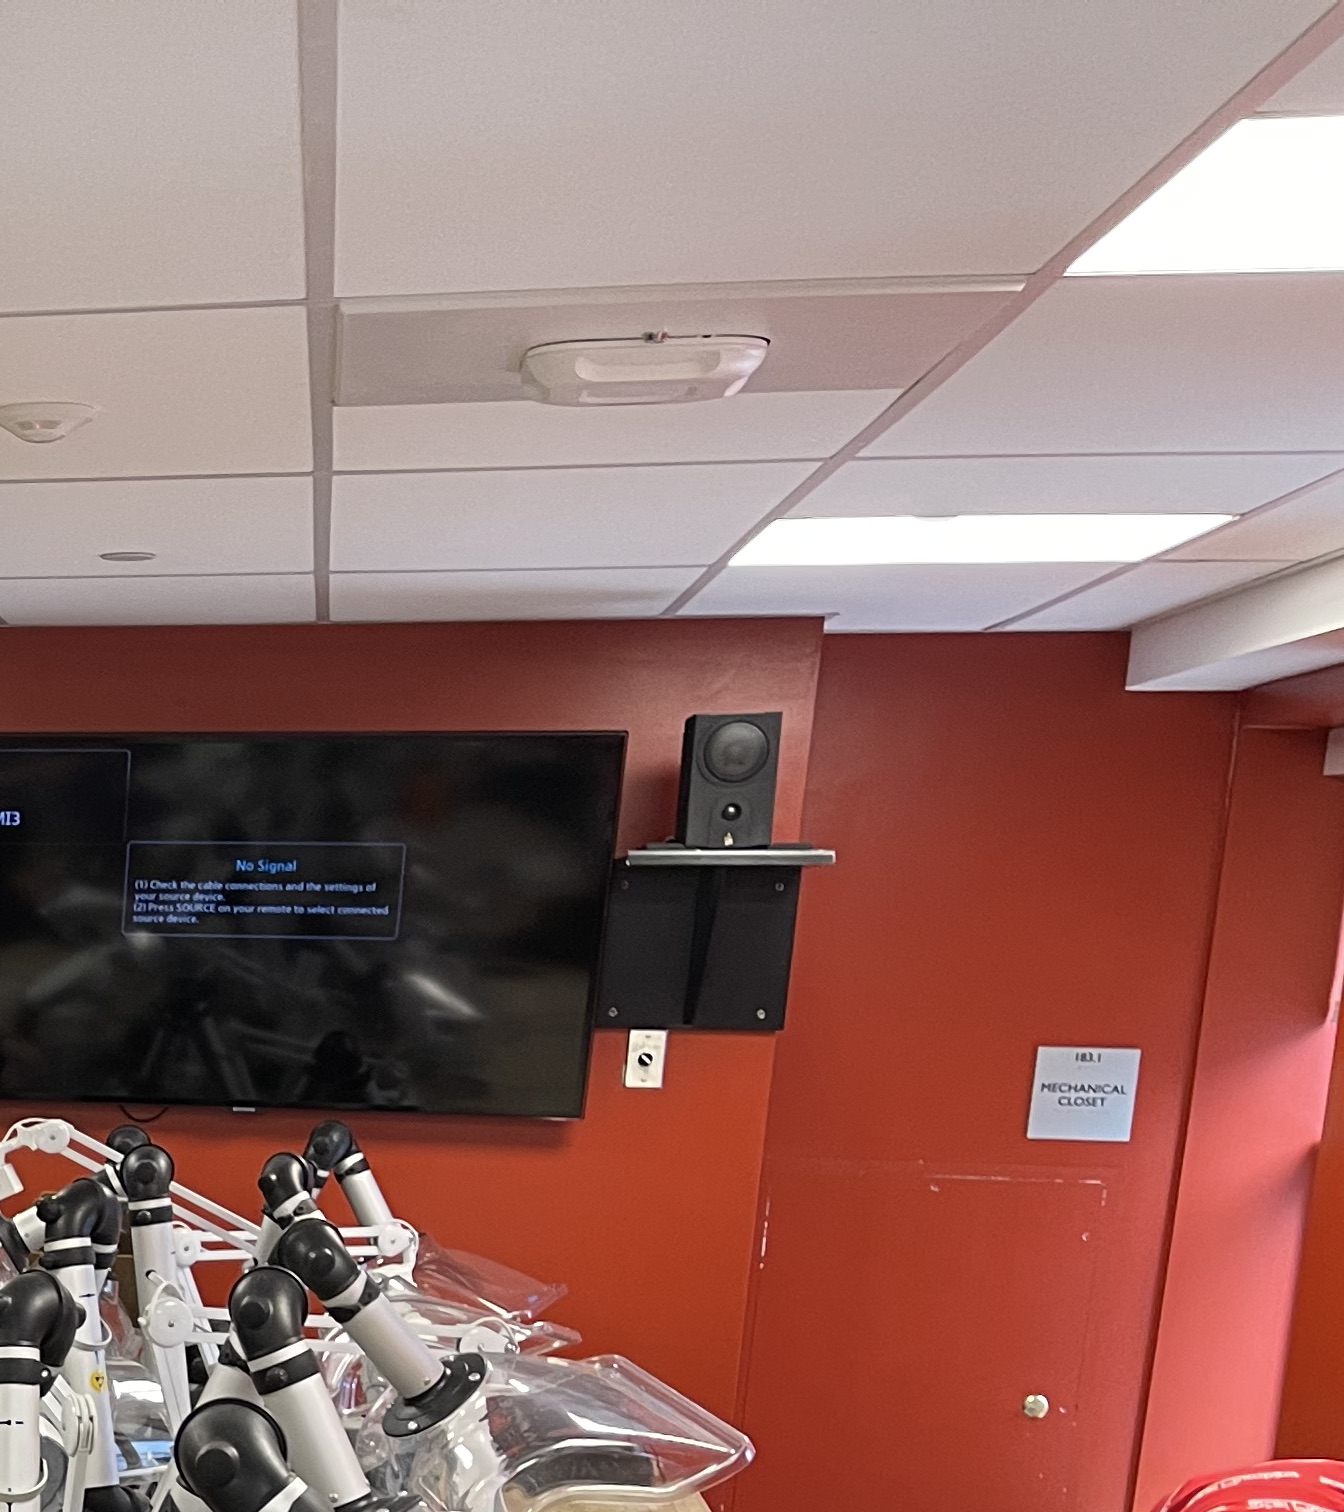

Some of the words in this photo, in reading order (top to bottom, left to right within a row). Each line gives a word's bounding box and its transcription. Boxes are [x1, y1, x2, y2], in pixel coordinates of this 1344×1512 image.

[235, 859, 254, 872] No
[256, 859, 297, 874] Signal
[150, 880, 177, 890] Check
[180, 880, 196, 889] the
[197, 881, 223, 891] cable
[224, 882, 283, 892] connections
[285, 882, 305, 892] and
[306, 882, 321, 892] the
[324, 882, 363, 894] settings
[133, 893, 157, 902] your
[159, 892, 190, 901] source
[148, 903, 174, 912] Press
[176, 903, 216, 912] SOURCE
[218, 905, 231, 913] on
[233, 906, 255, 915] your
[257, 905, 292, 914] remote
[293, 906, 305, 914] to
[307, 905, 335, 914] select
[337, 906, 389, 915] connected
[1040, 1082, 1127, 1095] MECHANICAL
[1057, 1096, 1107, 1107] CLOSET
